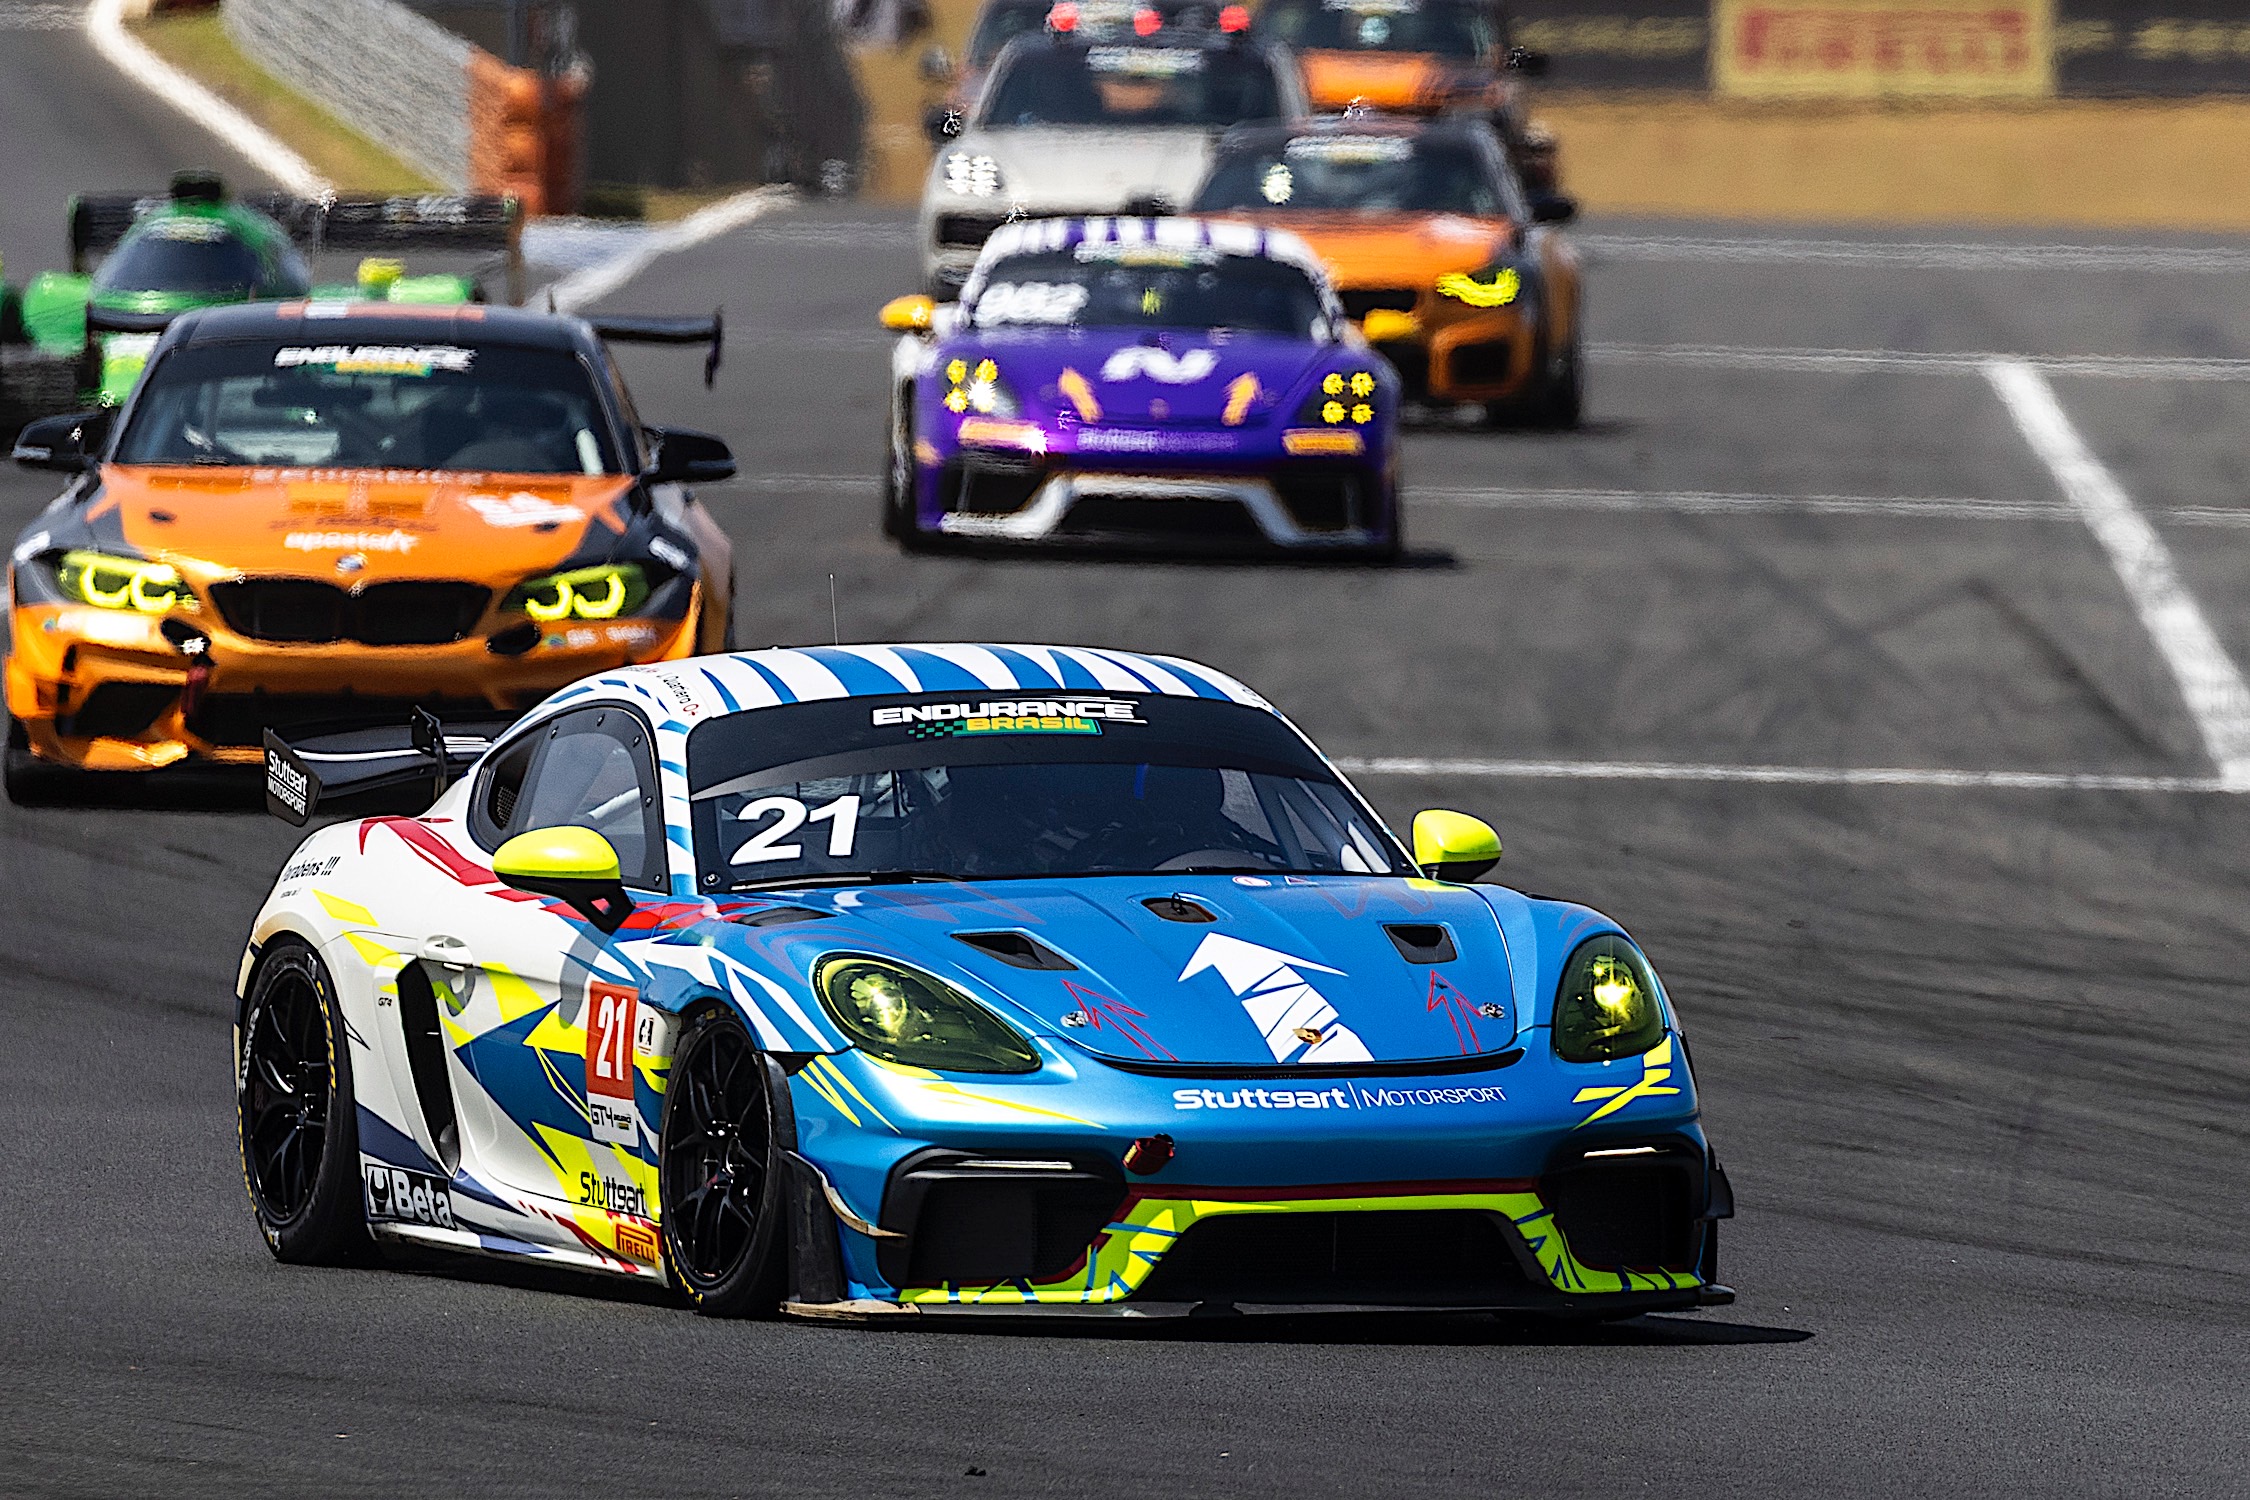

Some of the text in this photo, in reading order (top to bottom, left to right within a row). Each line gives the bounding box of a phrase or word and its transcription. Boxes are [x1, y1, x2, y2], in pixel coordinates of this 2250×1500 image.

[872, 701, 1137, 726] ENDURANCE
[965, 716, 1094, 731] BRASIL
[268, 749, 308, 797] Stuttgart
[267, 775, 306, 816] MOTORSPORT
[729, 795, 861, 866] 21
[378, 997, 393, 1007] GT4
[595, 995, 628, 1081] 21
[1172, 1086, 1507, 1110] Stuttgart MOTORSPORT
[391, 1169, 455, 1229] Beta
[580, 1170, 647, 1214] Stuttgart
[615, 1223, 656, 1264] PIRELLI
